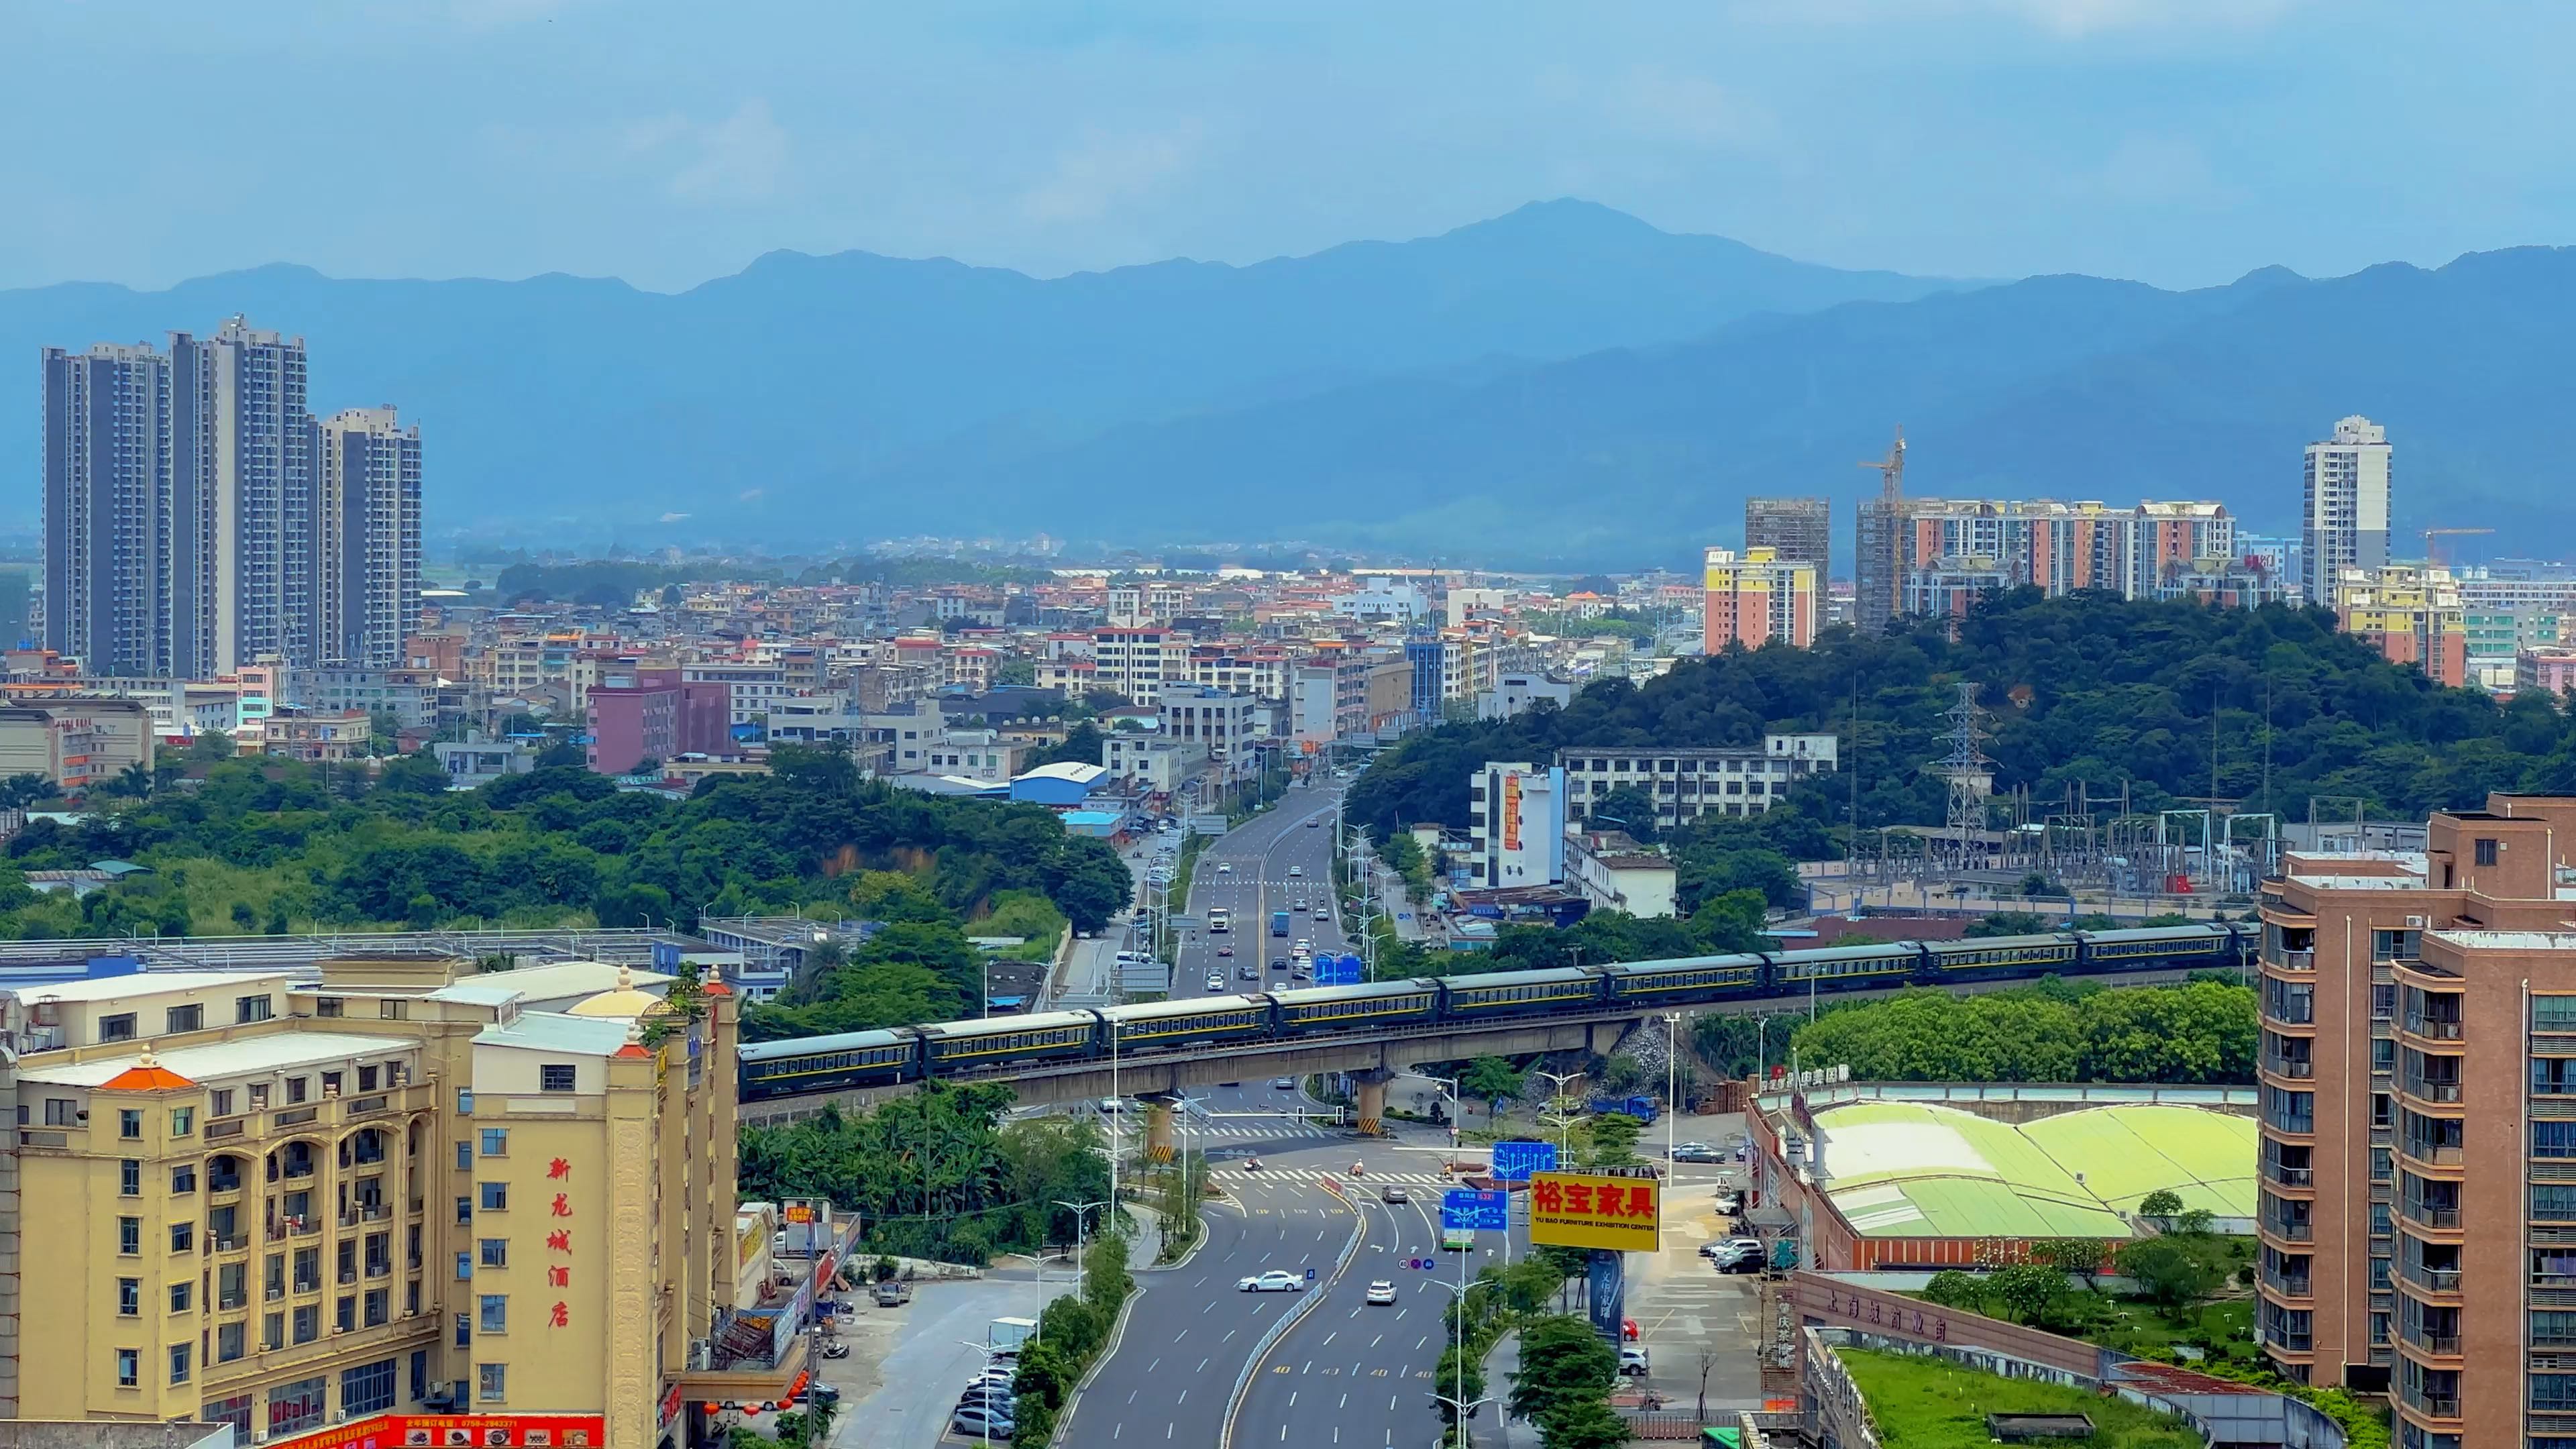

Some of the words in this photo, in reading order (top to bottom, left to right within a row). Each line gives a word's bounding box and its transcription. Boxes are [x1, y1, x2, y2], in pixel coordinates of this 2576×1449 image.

[1534, 1179, 1655, 1220] 裕宝家具
[546, 1157, 573, 1328] 新龙城酒店
[1560, 1219, 1593, 1227] FURNITURE
[1595, 1222, 1629, 1230] EXHIBITION
[1631, 1224, 1655, 1232] CENTER
[1828, 1290, 1946, 1342] 上海城商业街
[1273, 1366, 1291, 1374] 40
